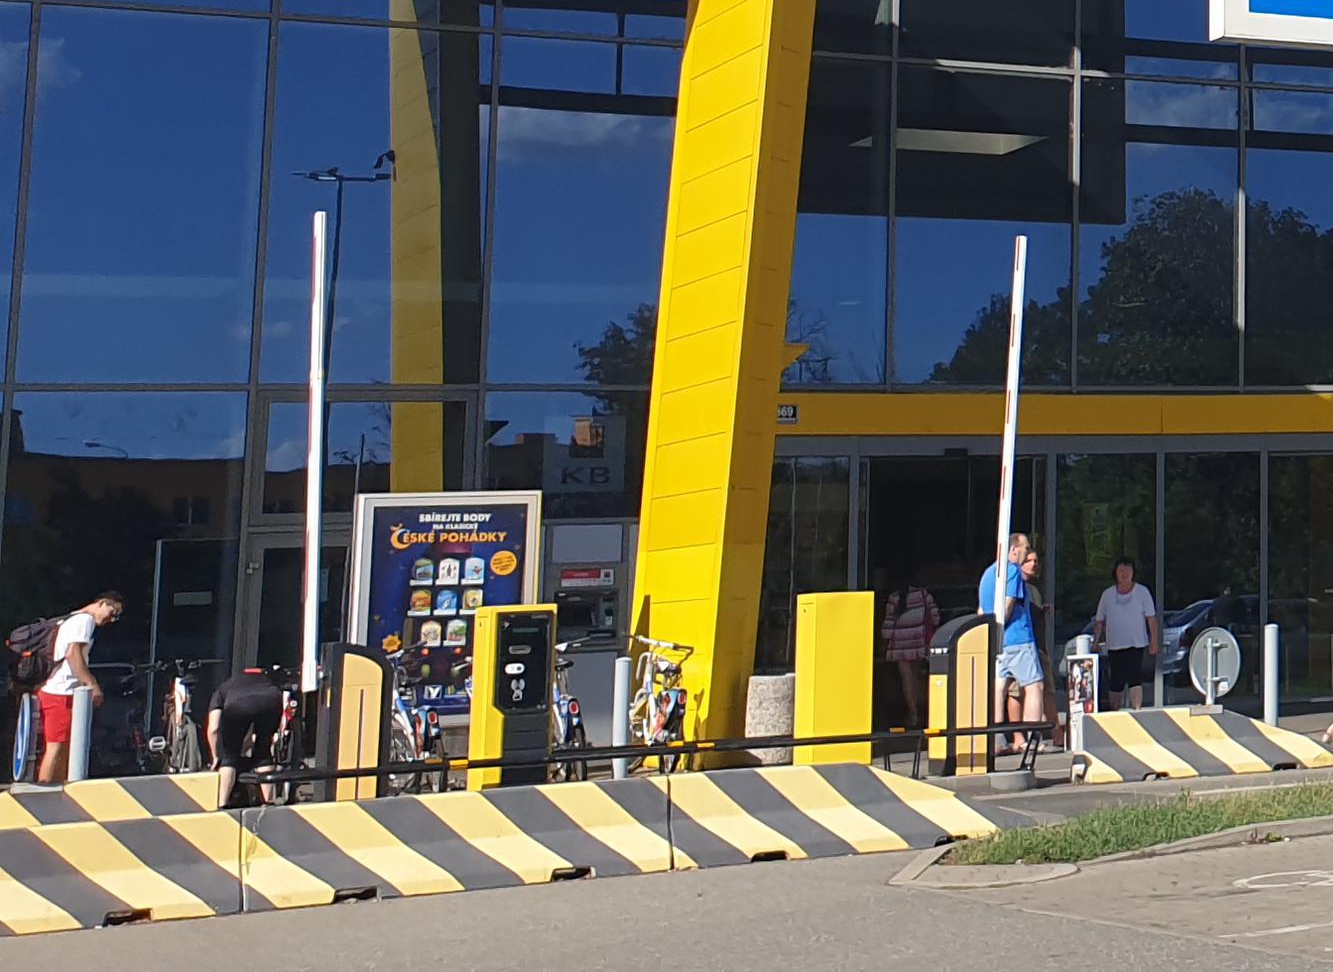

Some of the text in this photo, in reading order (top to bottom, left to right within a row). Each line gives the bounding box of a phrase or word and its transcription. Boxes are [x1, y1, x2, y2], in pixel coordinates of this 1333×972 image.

[560, 466, 610, 485] KB
[419, 512, 492, 523] SBÍREJTE BODY
[390, 523, 507, 549] ČESKÉ POHÁDKY
